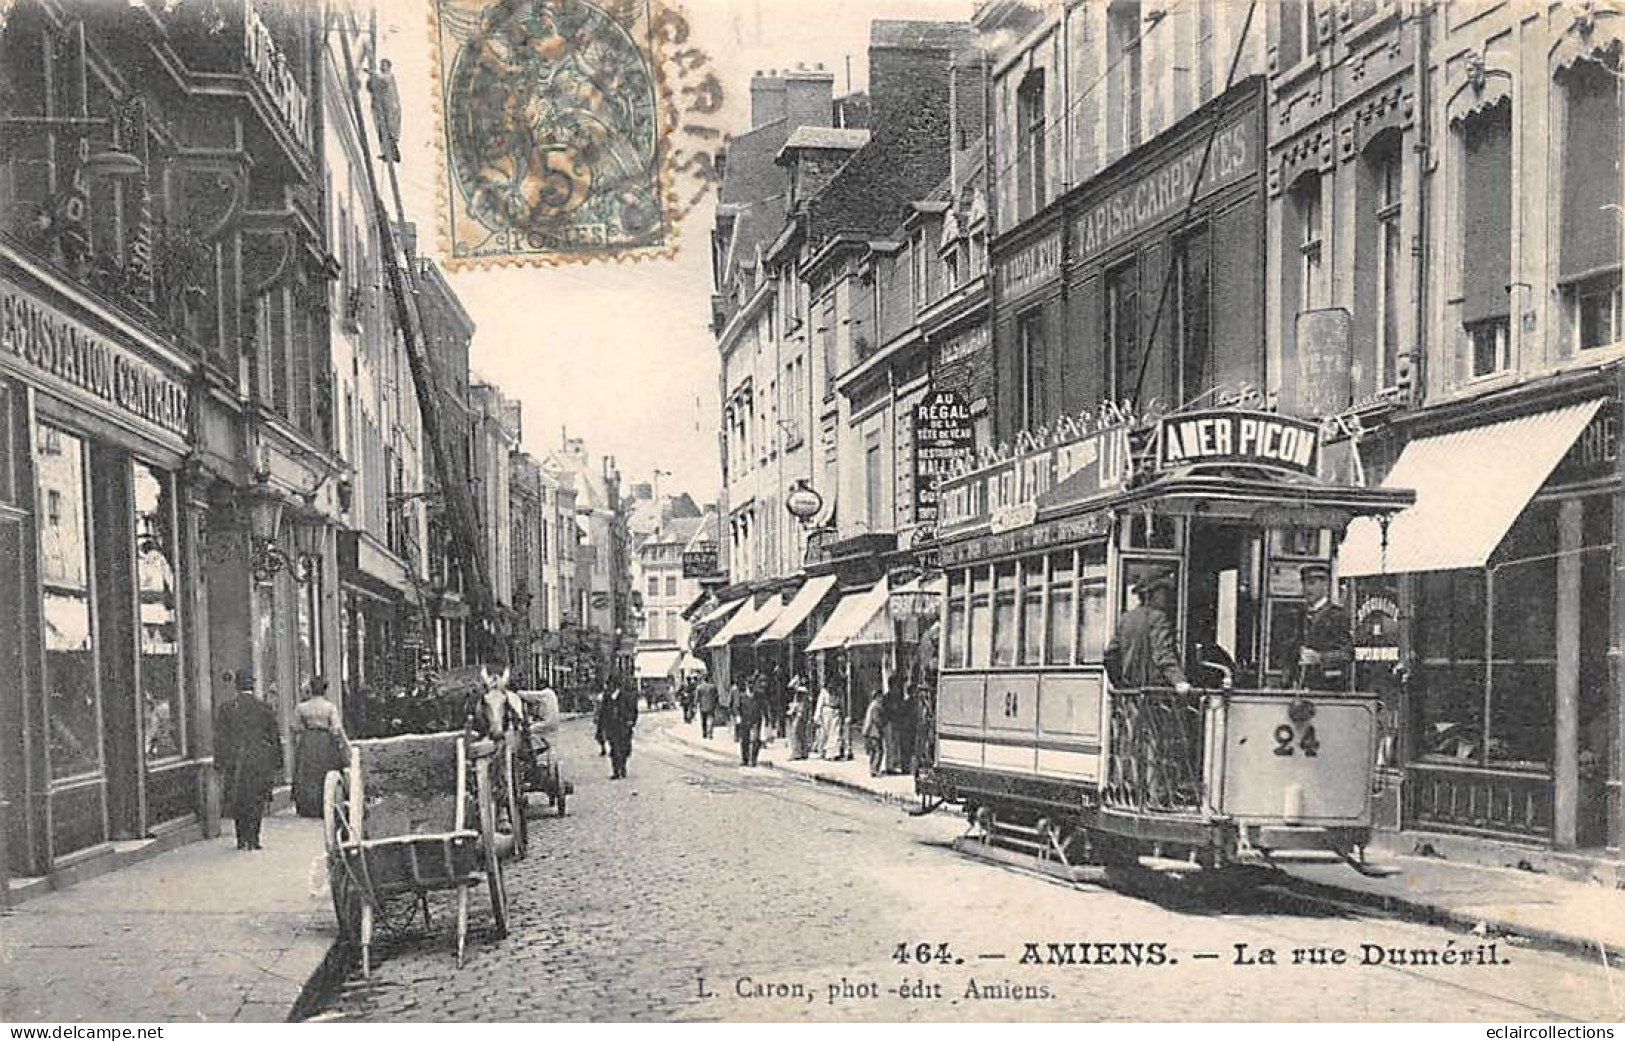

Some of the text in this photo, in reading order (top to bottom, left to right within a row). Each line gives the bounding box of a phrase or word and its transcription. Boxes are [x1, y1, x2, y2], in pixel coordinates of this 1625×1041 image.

[1077, 197, 1125, 255] TAPIS
[935, 393, 954, 405] AU
[930, 420, 957, 429] DE LA
[1239, 418, 1315, 467] PICON
[1273, 724, 1320, 757] 24
